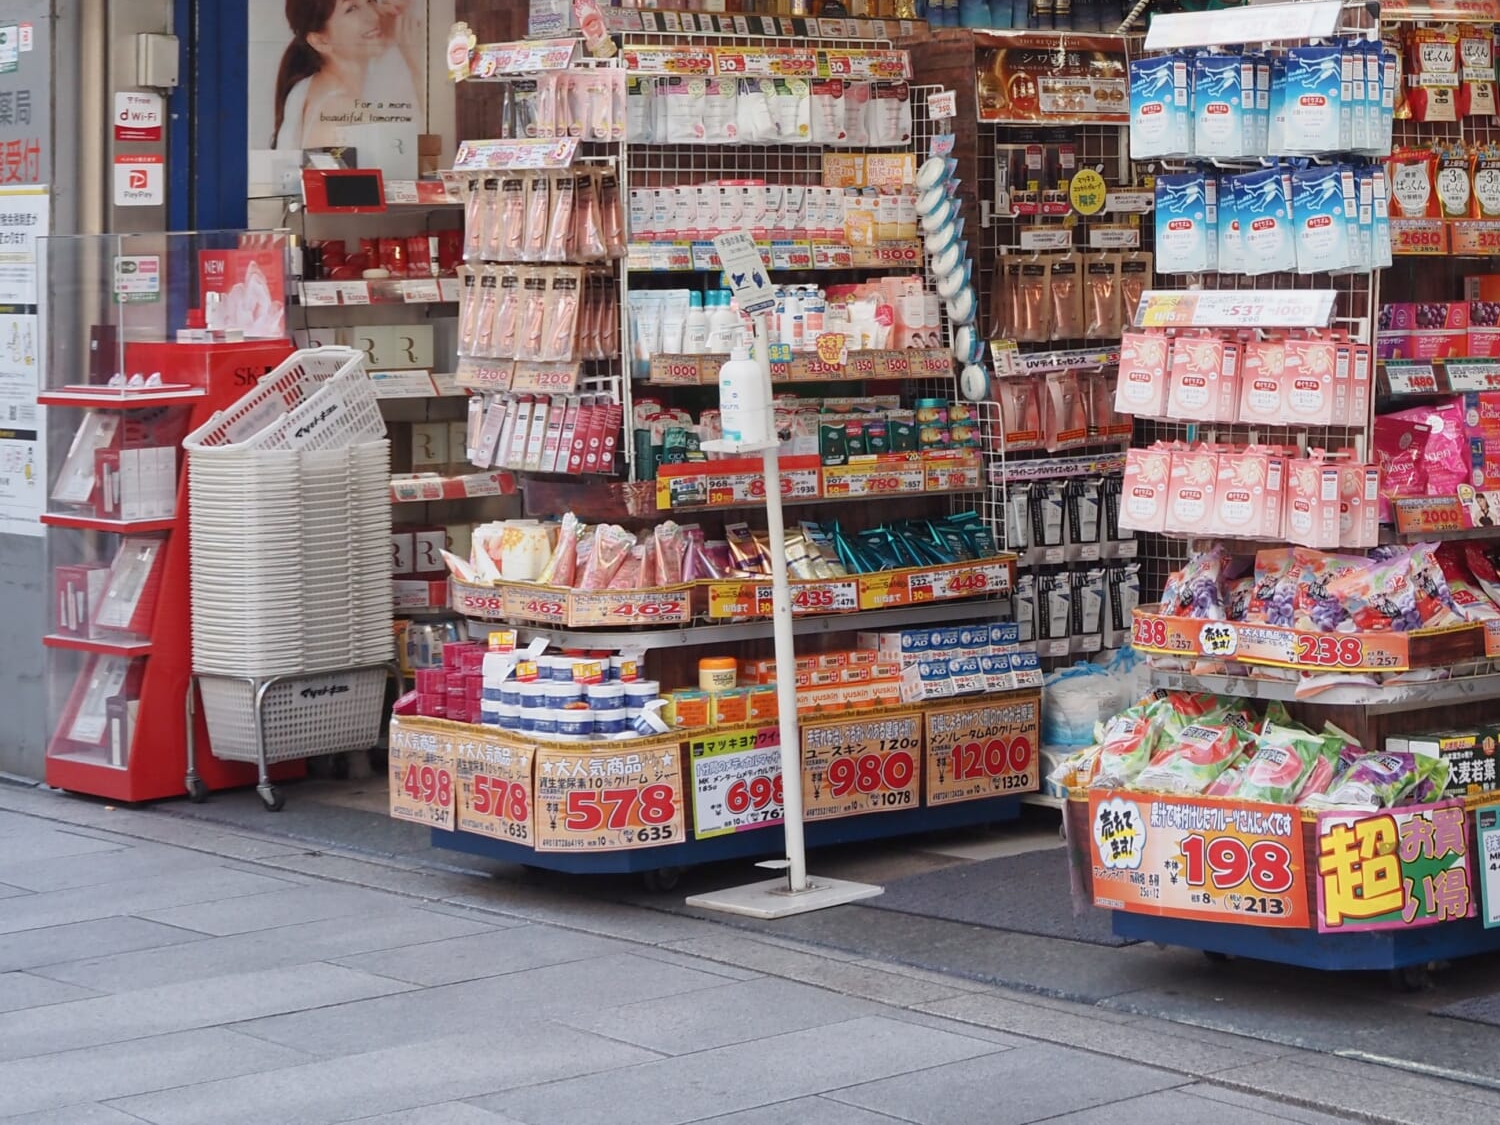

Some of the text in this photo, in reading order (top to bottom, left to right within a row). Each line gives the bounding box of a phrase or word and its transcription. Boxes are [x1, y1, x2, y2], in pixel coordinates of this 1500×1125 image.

[718, 60, 736, 72] 30
[131, 111, 157, 122] Wi-Fi
[369, 114, 412, 123] tomorrow
[0, 138, 41, 184] 受付
[123, 191, 152, 199] PayPay
[1401, 231, 1441, 246] 2680
[873, 248, 917, 261] 1800
[204, 260, 225, 274] NEW
[669, 364, 698, 377] 1000
[886, 359, 908, 372] 1500
[867, 477, 899, 490] 780
[1423, 509, 1458, 523] 2000
[950, 574, 987, 592] 448
[464, 596, 500, 609] 598
[795, 588, 834, 607] 435
[527, 600, 564, 616] 462
[613, 600, 683, 616] 462
[1132, 619, 1168, 646] 238
[1299, 636, 1363, 666] 238
[812, 692, 839, 705] yuskin
[842, 689, 869, 702] yuskin
[806, 743, 867, 761] ユースキン
[952, 735, 1032, 781] 1200
[548, 754, 643, 777] 大人気商品
[828, 750, 914, 799] 980
[1447, 758, 1496, 785] 大麦若葉
[404, 763, 451, 807] 498
[1002, 774, 1029, 790] 1320
[473, 773, 528, 823] 578
[725, 774, 785, 814] 698
[881, 791, 911, 806] 1078
[564, 783, 676, 832] 578
[1100, 809, 1133, 838] 売れて
[1400, 806, 1468, 863] お買
[1111, 837, 1134, 860] ます!
[1180, 834, 1294, 894] 198
[1318, 815, 1403, 928] 超
[1244, 896, 1284, 915] 213
[1401, 870, 1469, 924] い得
